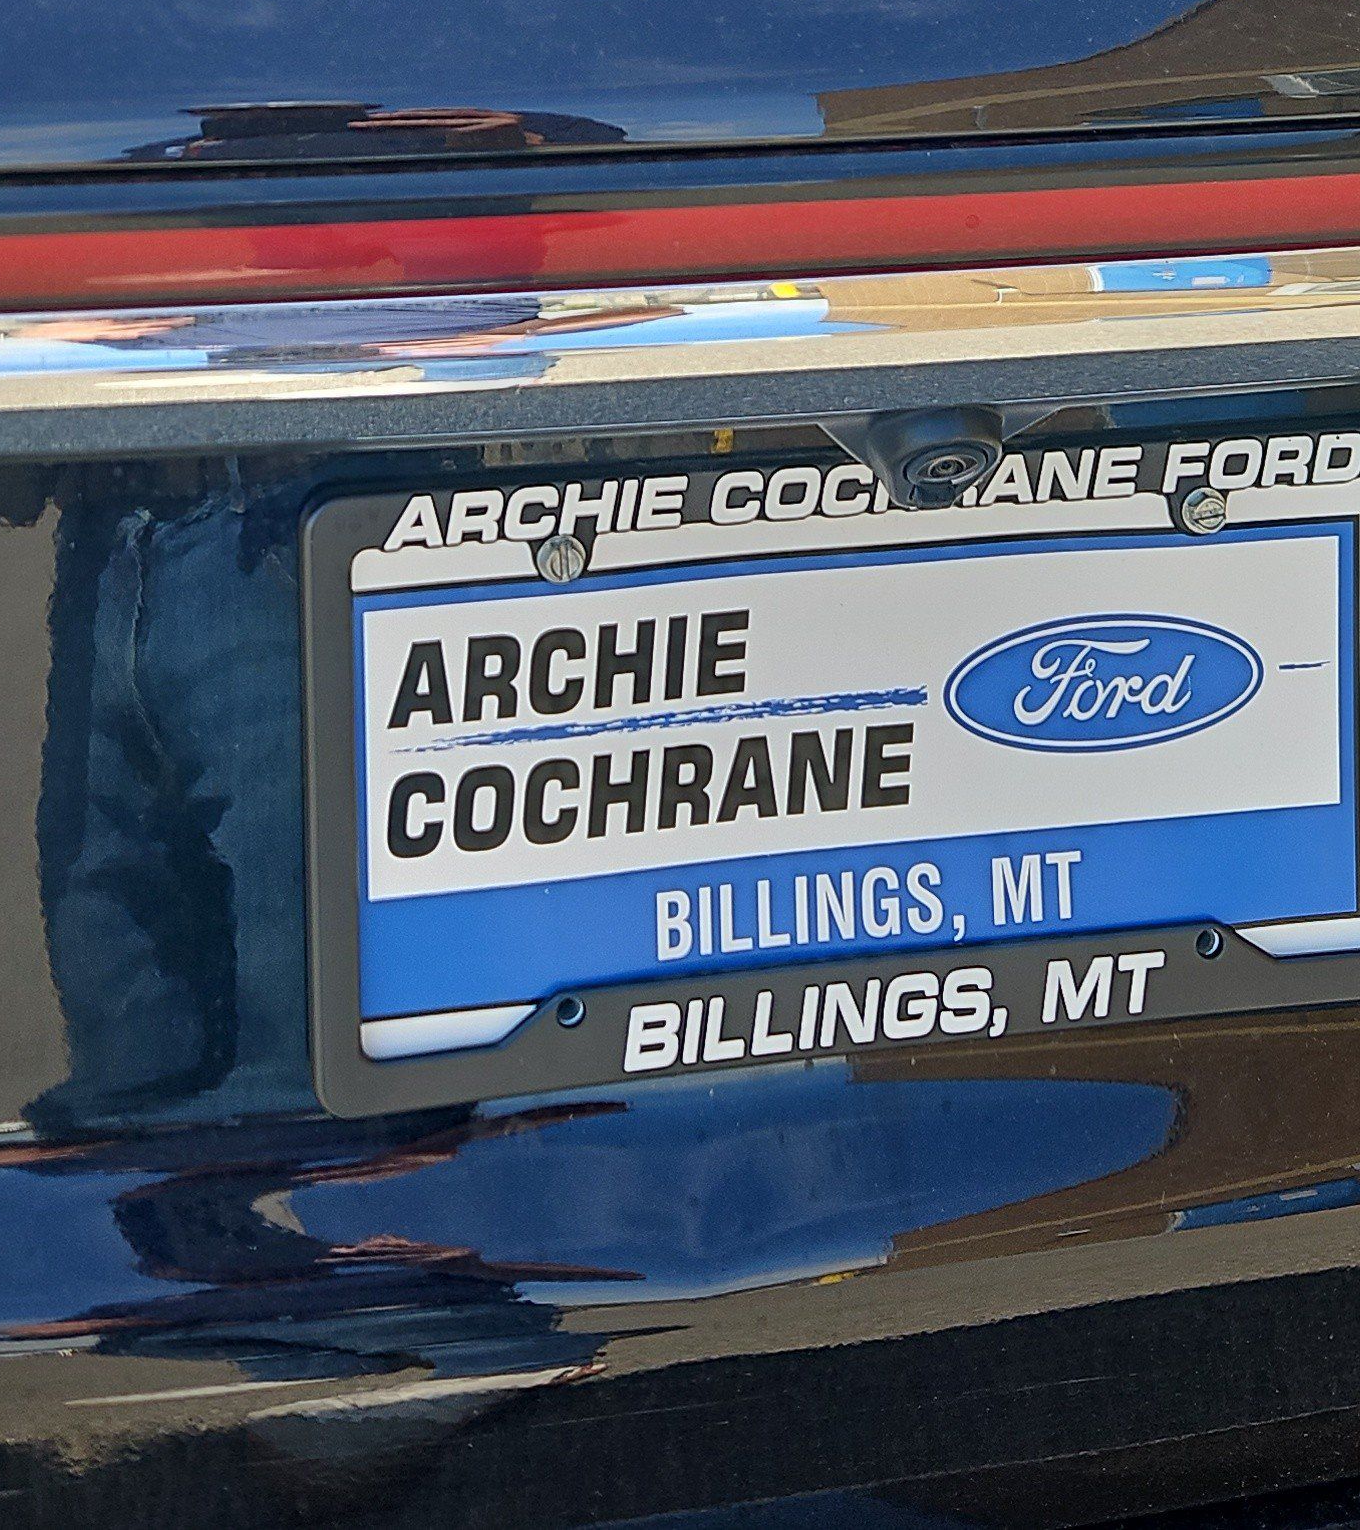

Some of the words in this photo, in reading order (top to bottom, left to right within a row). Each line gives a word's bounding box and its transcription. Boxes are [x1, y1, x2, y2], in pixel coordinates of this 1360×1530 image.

[382, 473, 689, 552] ARCHIE
[710, 445, 1143, 525] COCANE
[387, 608, 750, 730] ARCHIE
[1013, 636, 1194, 726] Ford
[386, 722, 915, 860] COCHRANE
[653, 861, 967, 963] BILLINGS,
[990, 849, 1083, 926] MT
[623, 965, 1009, 1074] BILLINGS,
[1040, 949, 1166, 1024] MT
